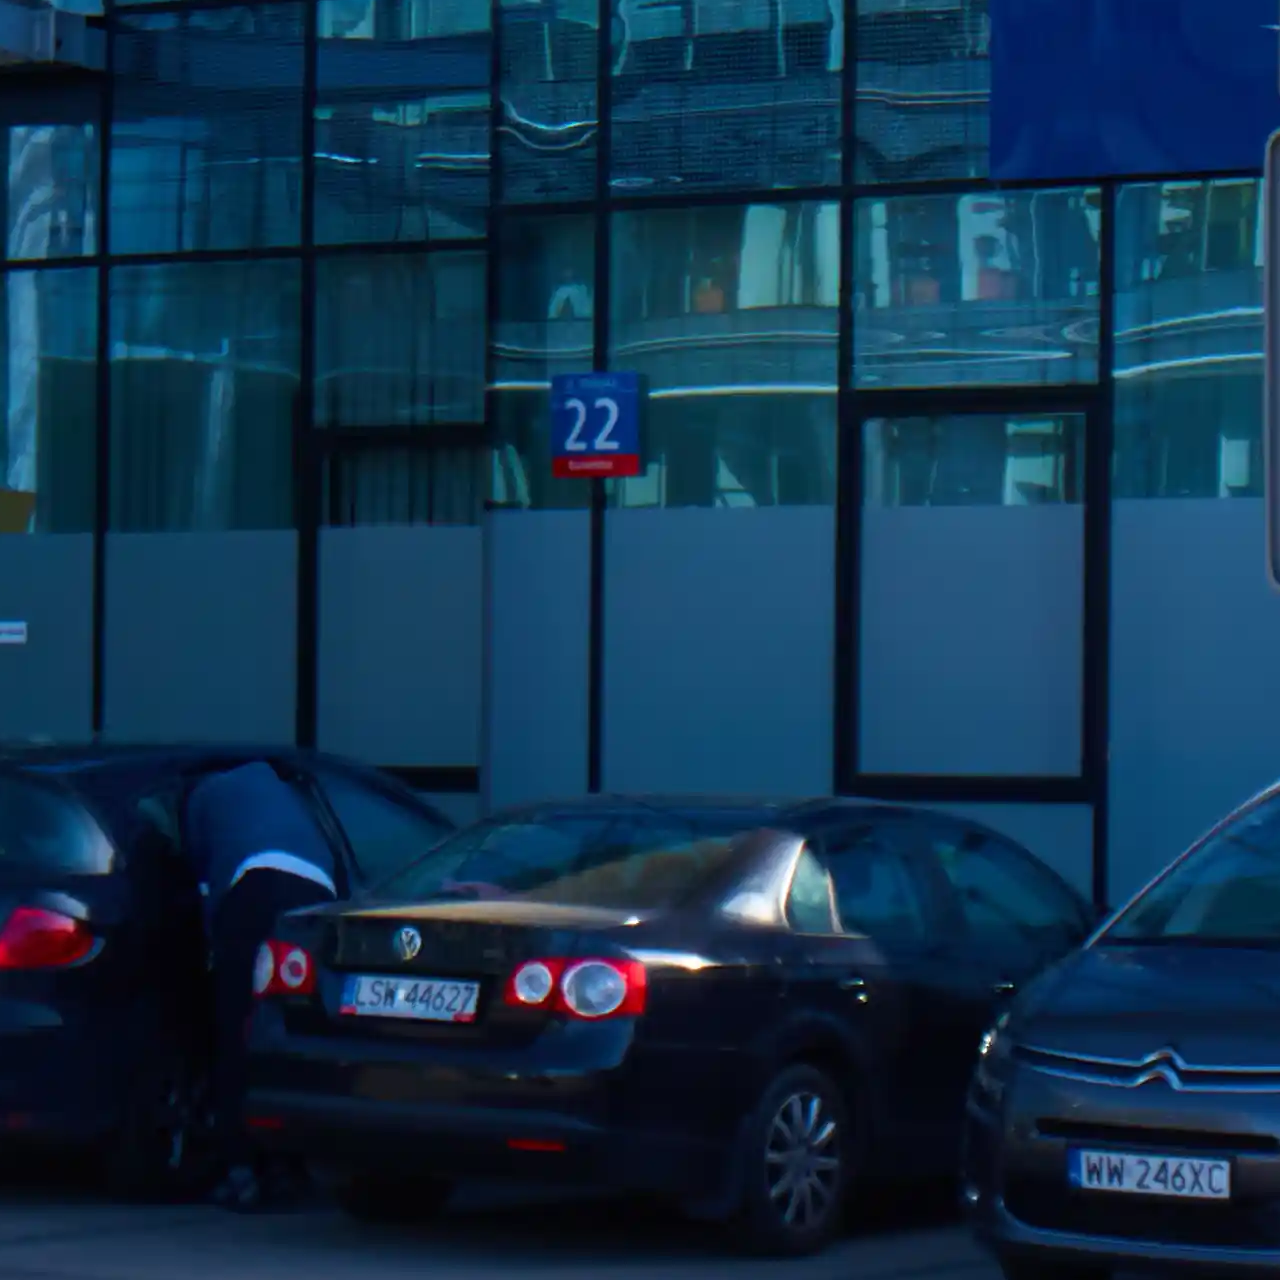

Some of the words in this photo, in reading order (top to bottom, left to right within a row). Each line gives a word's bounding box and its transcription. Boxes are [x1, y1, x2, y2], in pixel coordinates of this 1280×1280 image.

[564, 397, 620, 451] 22
[1086, 1155, 1124, 1187] WW
[1136, 1158, 1224, 1194] 246XC
